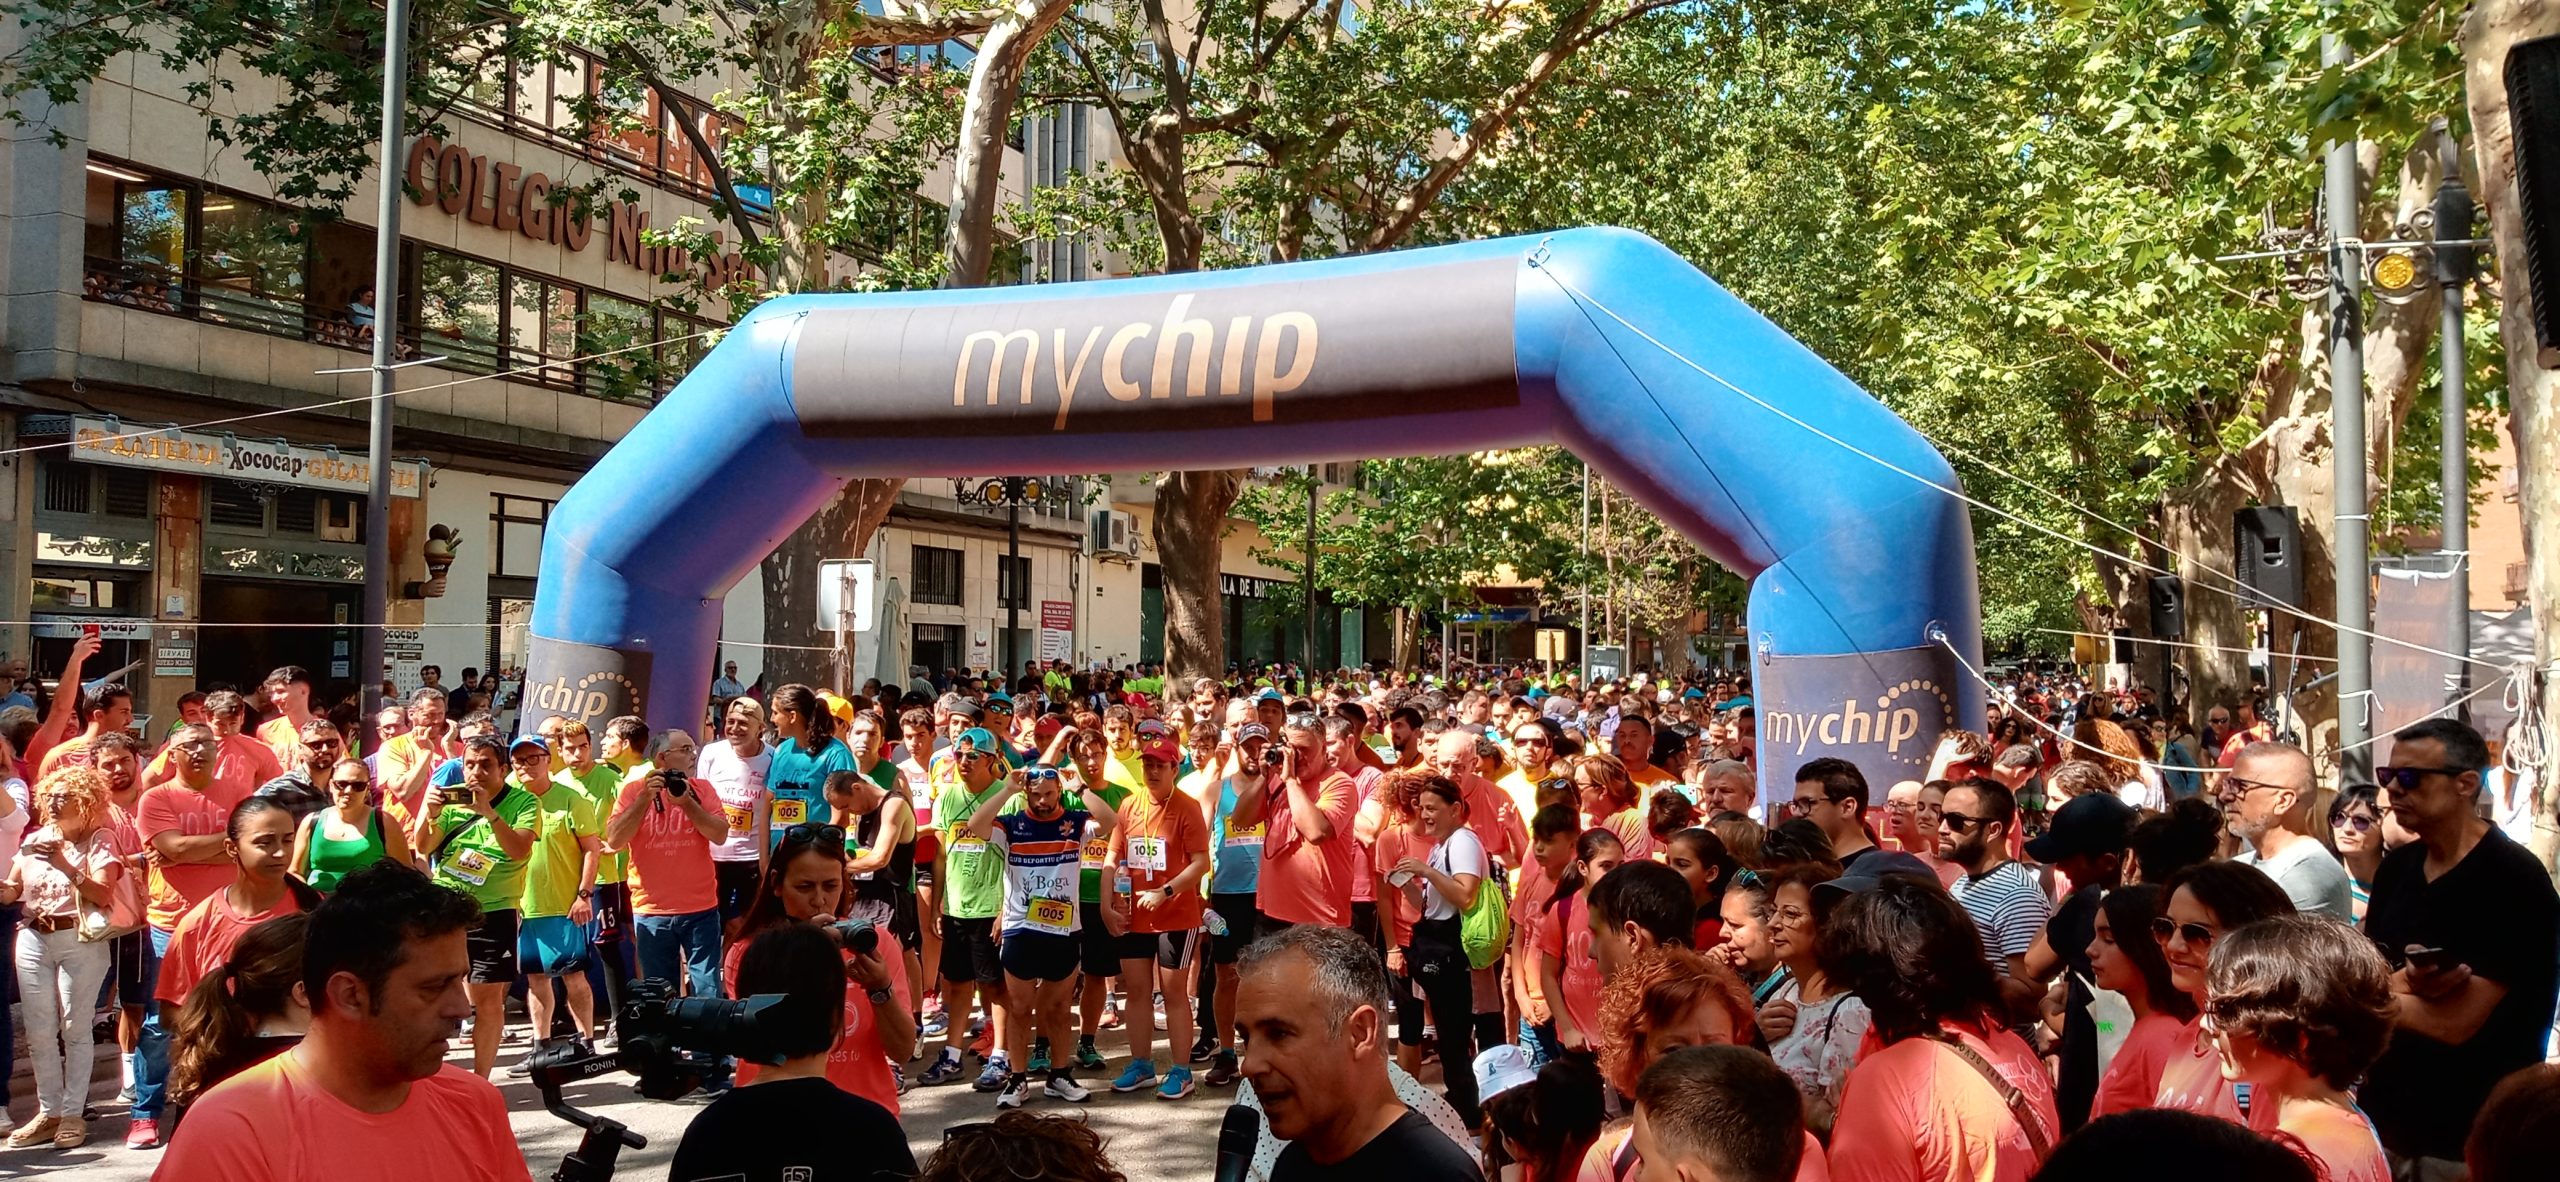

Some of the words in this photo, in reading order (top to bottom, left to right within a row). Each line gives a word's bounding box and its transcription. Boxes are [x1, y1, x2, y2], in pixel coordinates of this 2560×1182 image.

[407, 135, 594, 252] COLEGIO
[952, 291, 1320, 432] mychip
[229, 446, 302, 478] Xococap
[306, 457, 417, 489] GELATIA
[1239, 577, 1251, 597] DE
[384, 629, 419, 642] ococap
[1766, 696, 1919, 756] mychip
[912, 789, 923, 797] 05
[777, 806, 799, 818] 1005
[1034, 874, 1070, 892] Boga
[1037, 906, 1065, 921] 1005
[583, 1058, 617, 1075] RONIN
